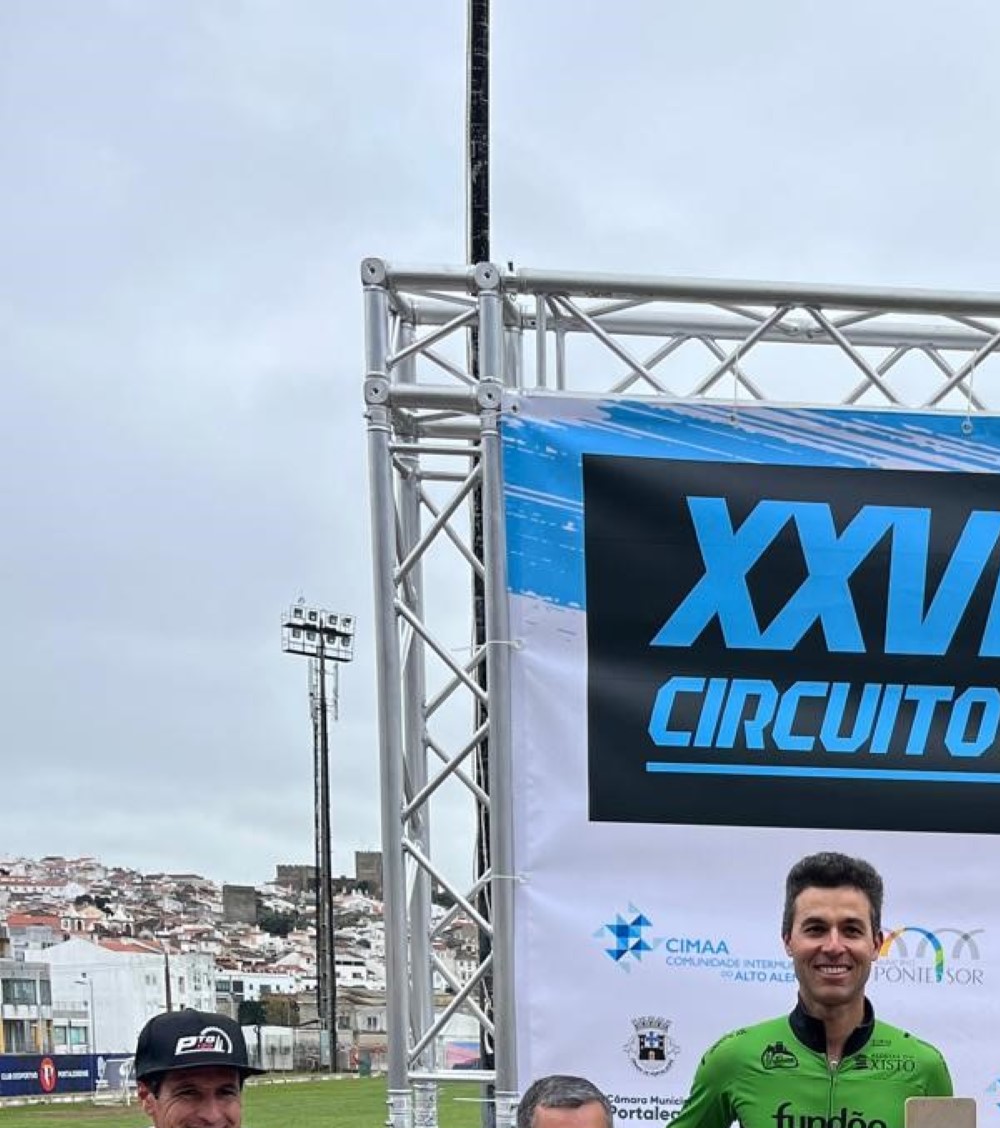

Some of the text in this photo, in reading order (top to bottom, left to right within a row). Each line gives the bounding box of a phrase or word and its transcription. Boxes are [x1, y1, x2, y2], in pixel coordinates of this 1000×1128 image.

[666, 938, 729, 954] CIMAA
[735, 971, 767, 982] ALTO
[870, 1059, 915, 1071] XISTO
